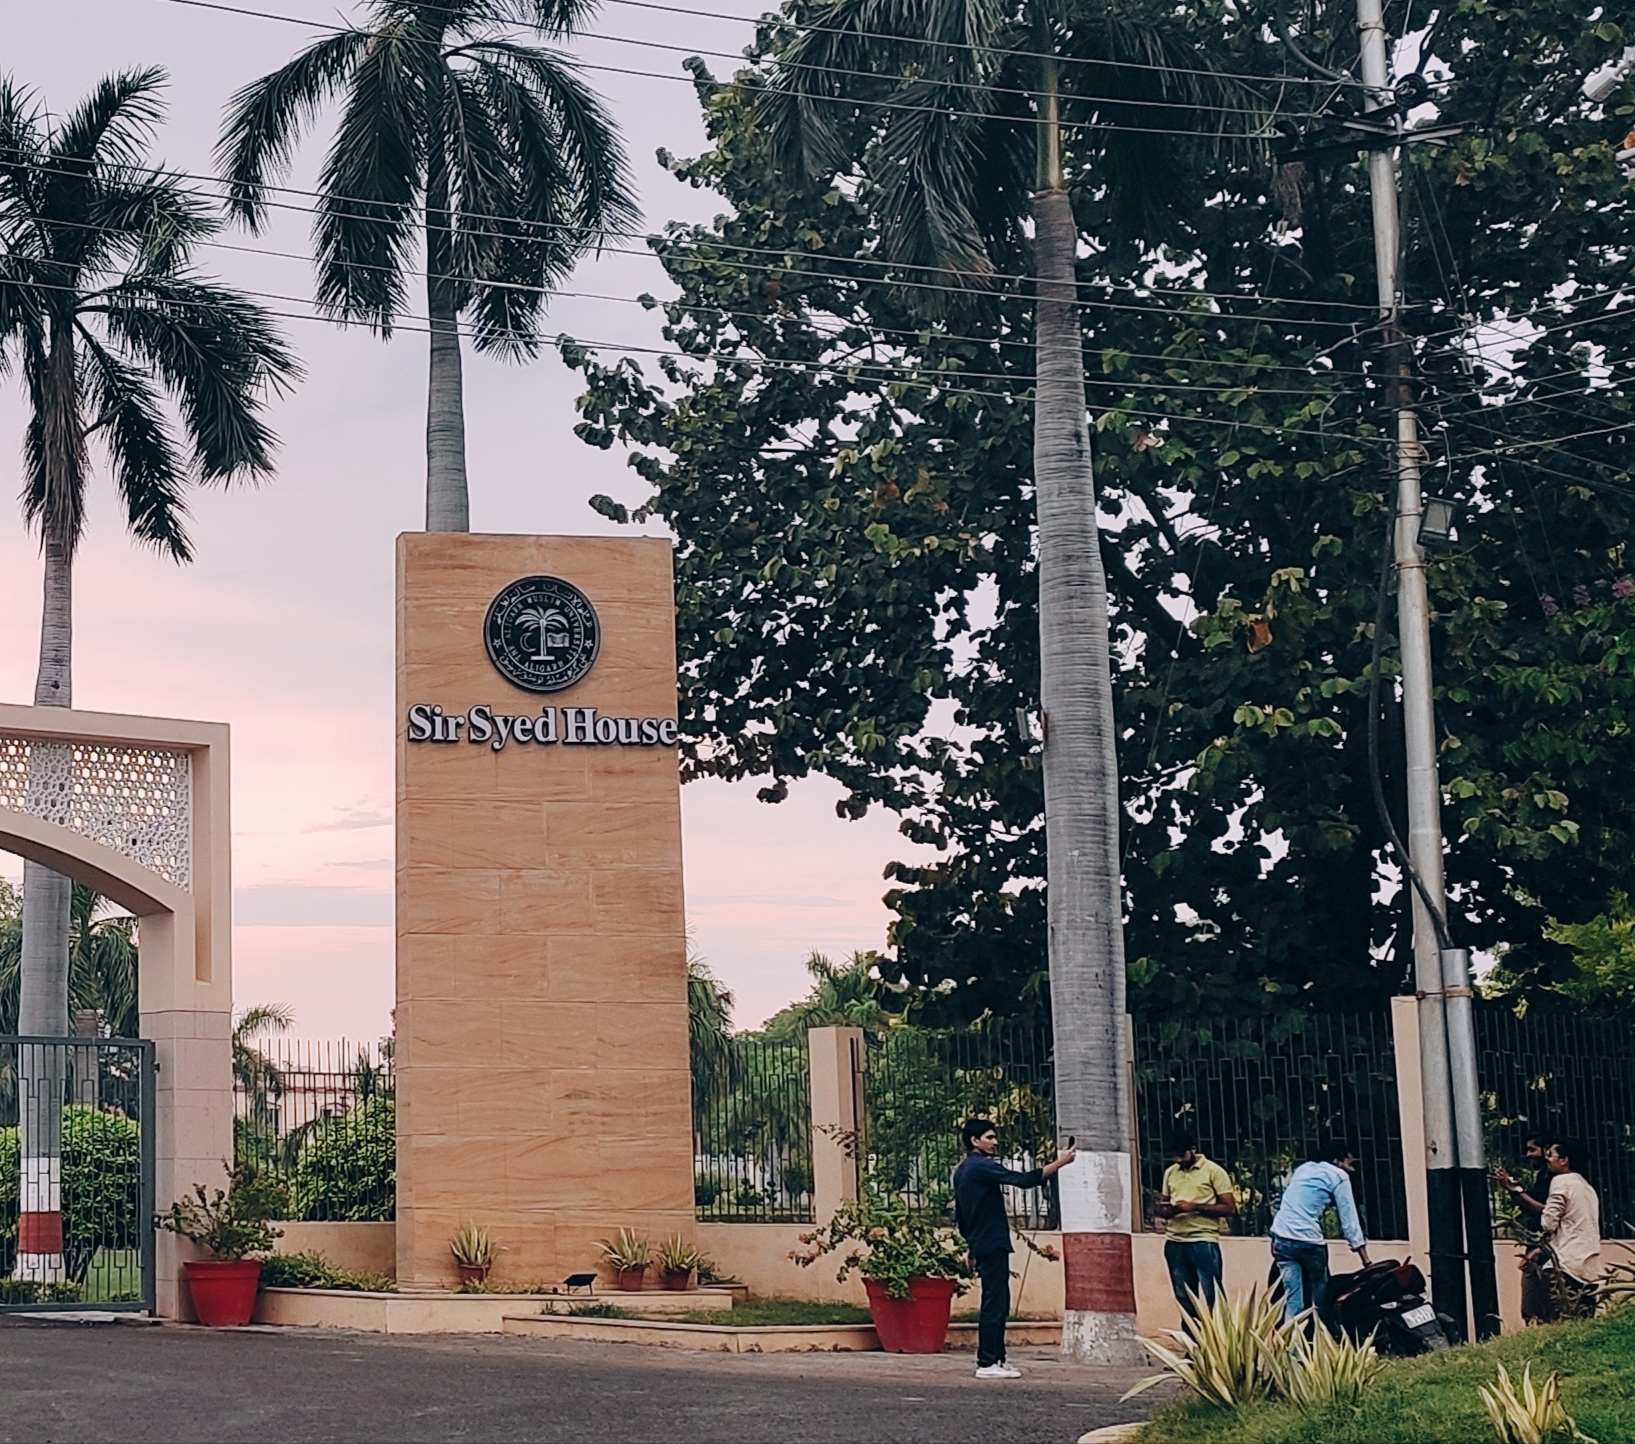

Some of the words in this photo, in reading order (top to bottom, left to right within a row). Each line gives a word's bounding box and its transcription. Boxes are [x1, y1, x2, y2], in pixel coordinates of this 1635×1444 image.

[527, 594, 561, 606] MUSLIM
[564, 606, 581, 661] UNIVERSITY
[524, 660, 564, 673] ALIGARH
[407, 704, 465, 743] Sir
[468, 704, 558, 751] Syed
[563, 707, 679, 745] House
